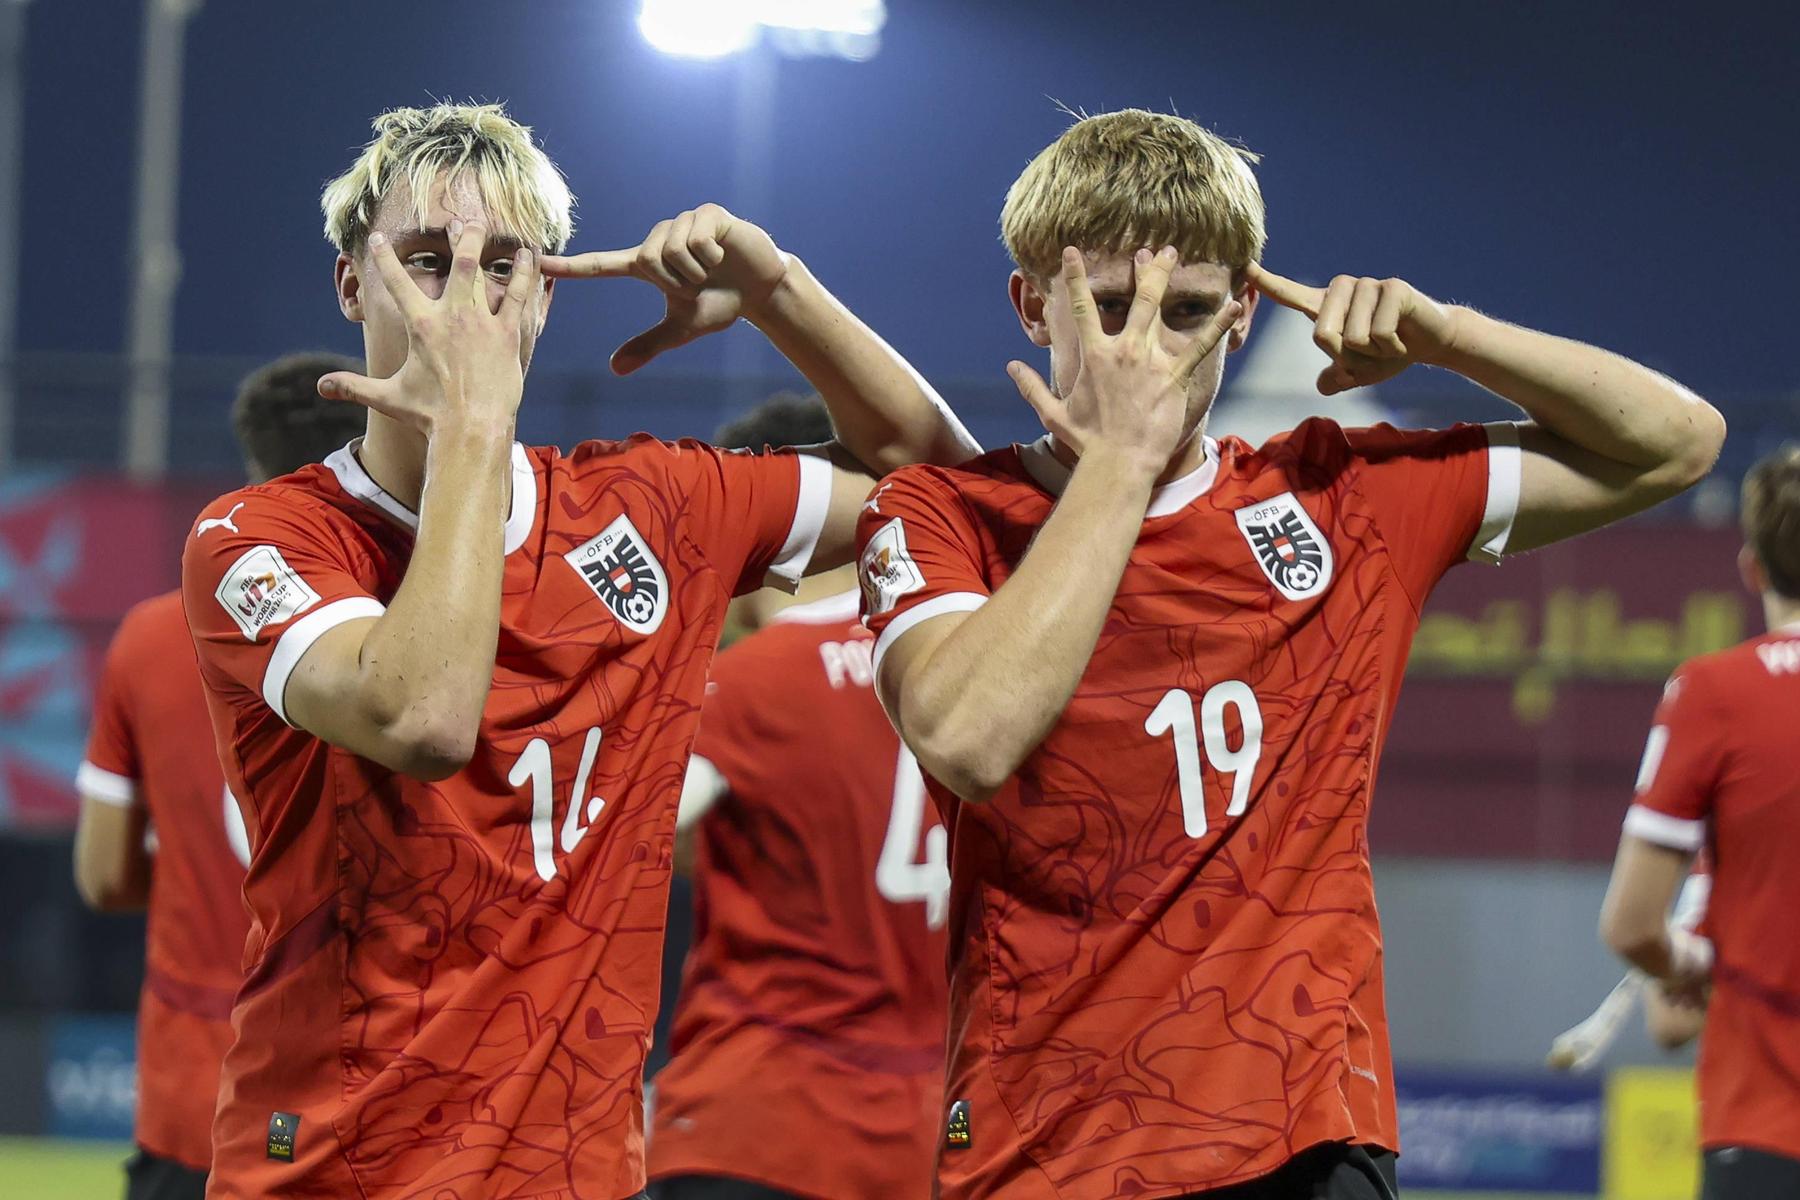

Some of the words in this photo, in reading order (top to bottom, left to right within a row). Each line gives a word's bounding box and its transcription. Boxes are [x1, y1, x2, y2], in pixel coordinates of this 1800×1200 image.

[240, 575, 254, 592] FIFA
[253, 599, 271, 627] WORLD
[271, 584, 287, 599] CUP
[1145, 680, 1263, 838] 19
[876, 738, 951, 931] 4
